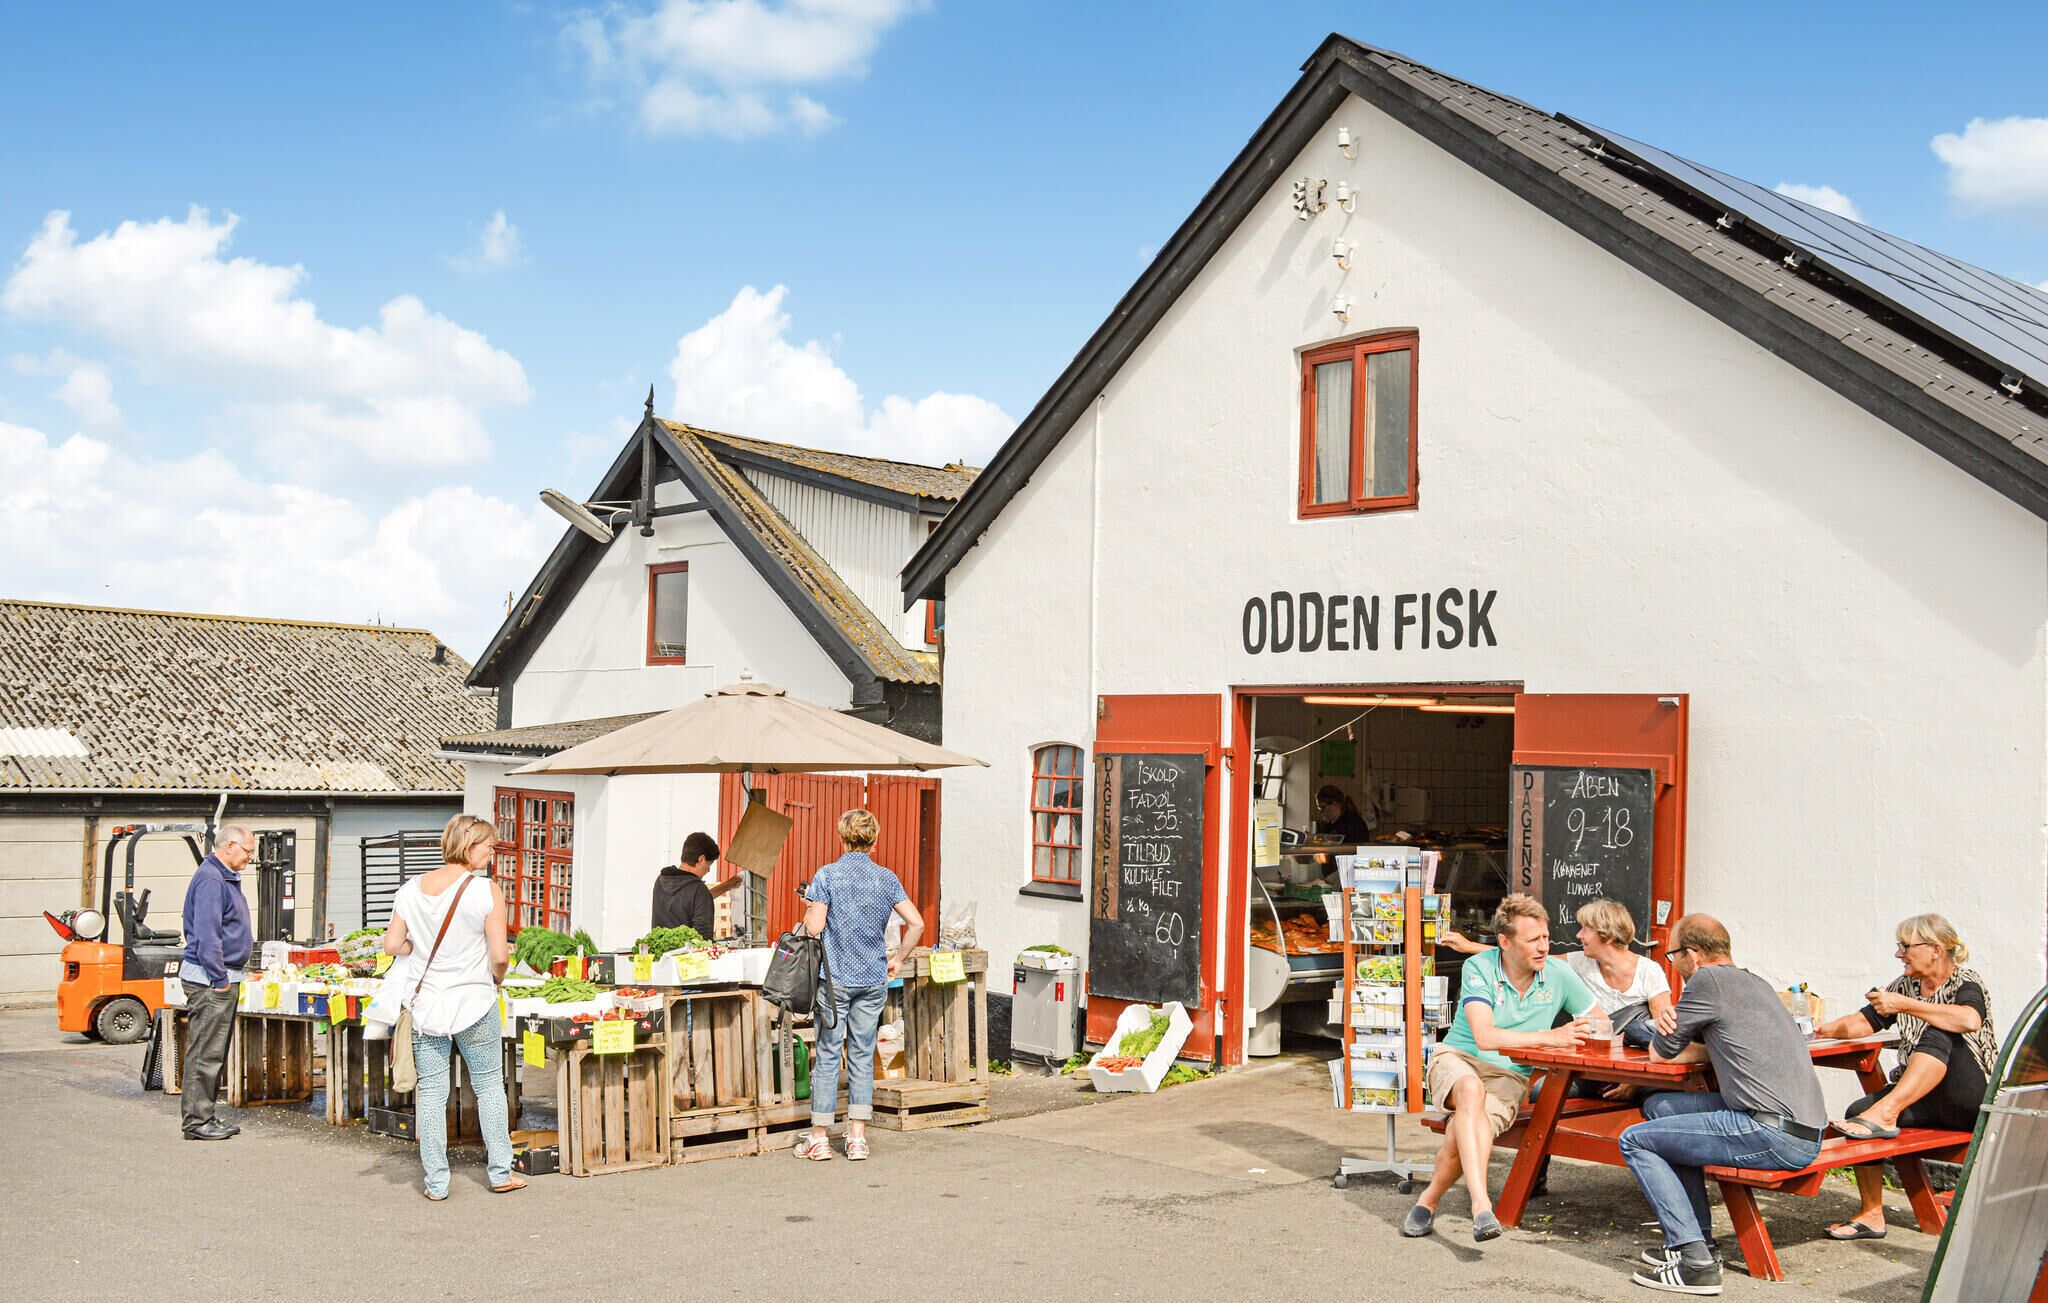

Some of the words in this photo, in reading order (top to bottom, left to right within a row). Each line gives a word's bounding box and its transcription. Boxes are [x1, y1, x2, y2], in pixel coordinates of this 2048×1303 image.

[1242, 591, 1380, 655] ODDEN
[1394, 587, 1497, 650] FISK
[1103, 757, 1113, 849] DAGENS
[1128, 789, 1176, 809] FADØL
[1571, 771, 1620, 799] ÅBEN
[1521, 772, 1534, 886] DAGENS
[1567, 807, 1634, 852] 9-18
[1123, 842, 1171, 863] TILBUD
[1101, 856, 1109, 920] FISK
[1151, 880, 1183, 898] FILET
[163, 961, 180, 974] 18
